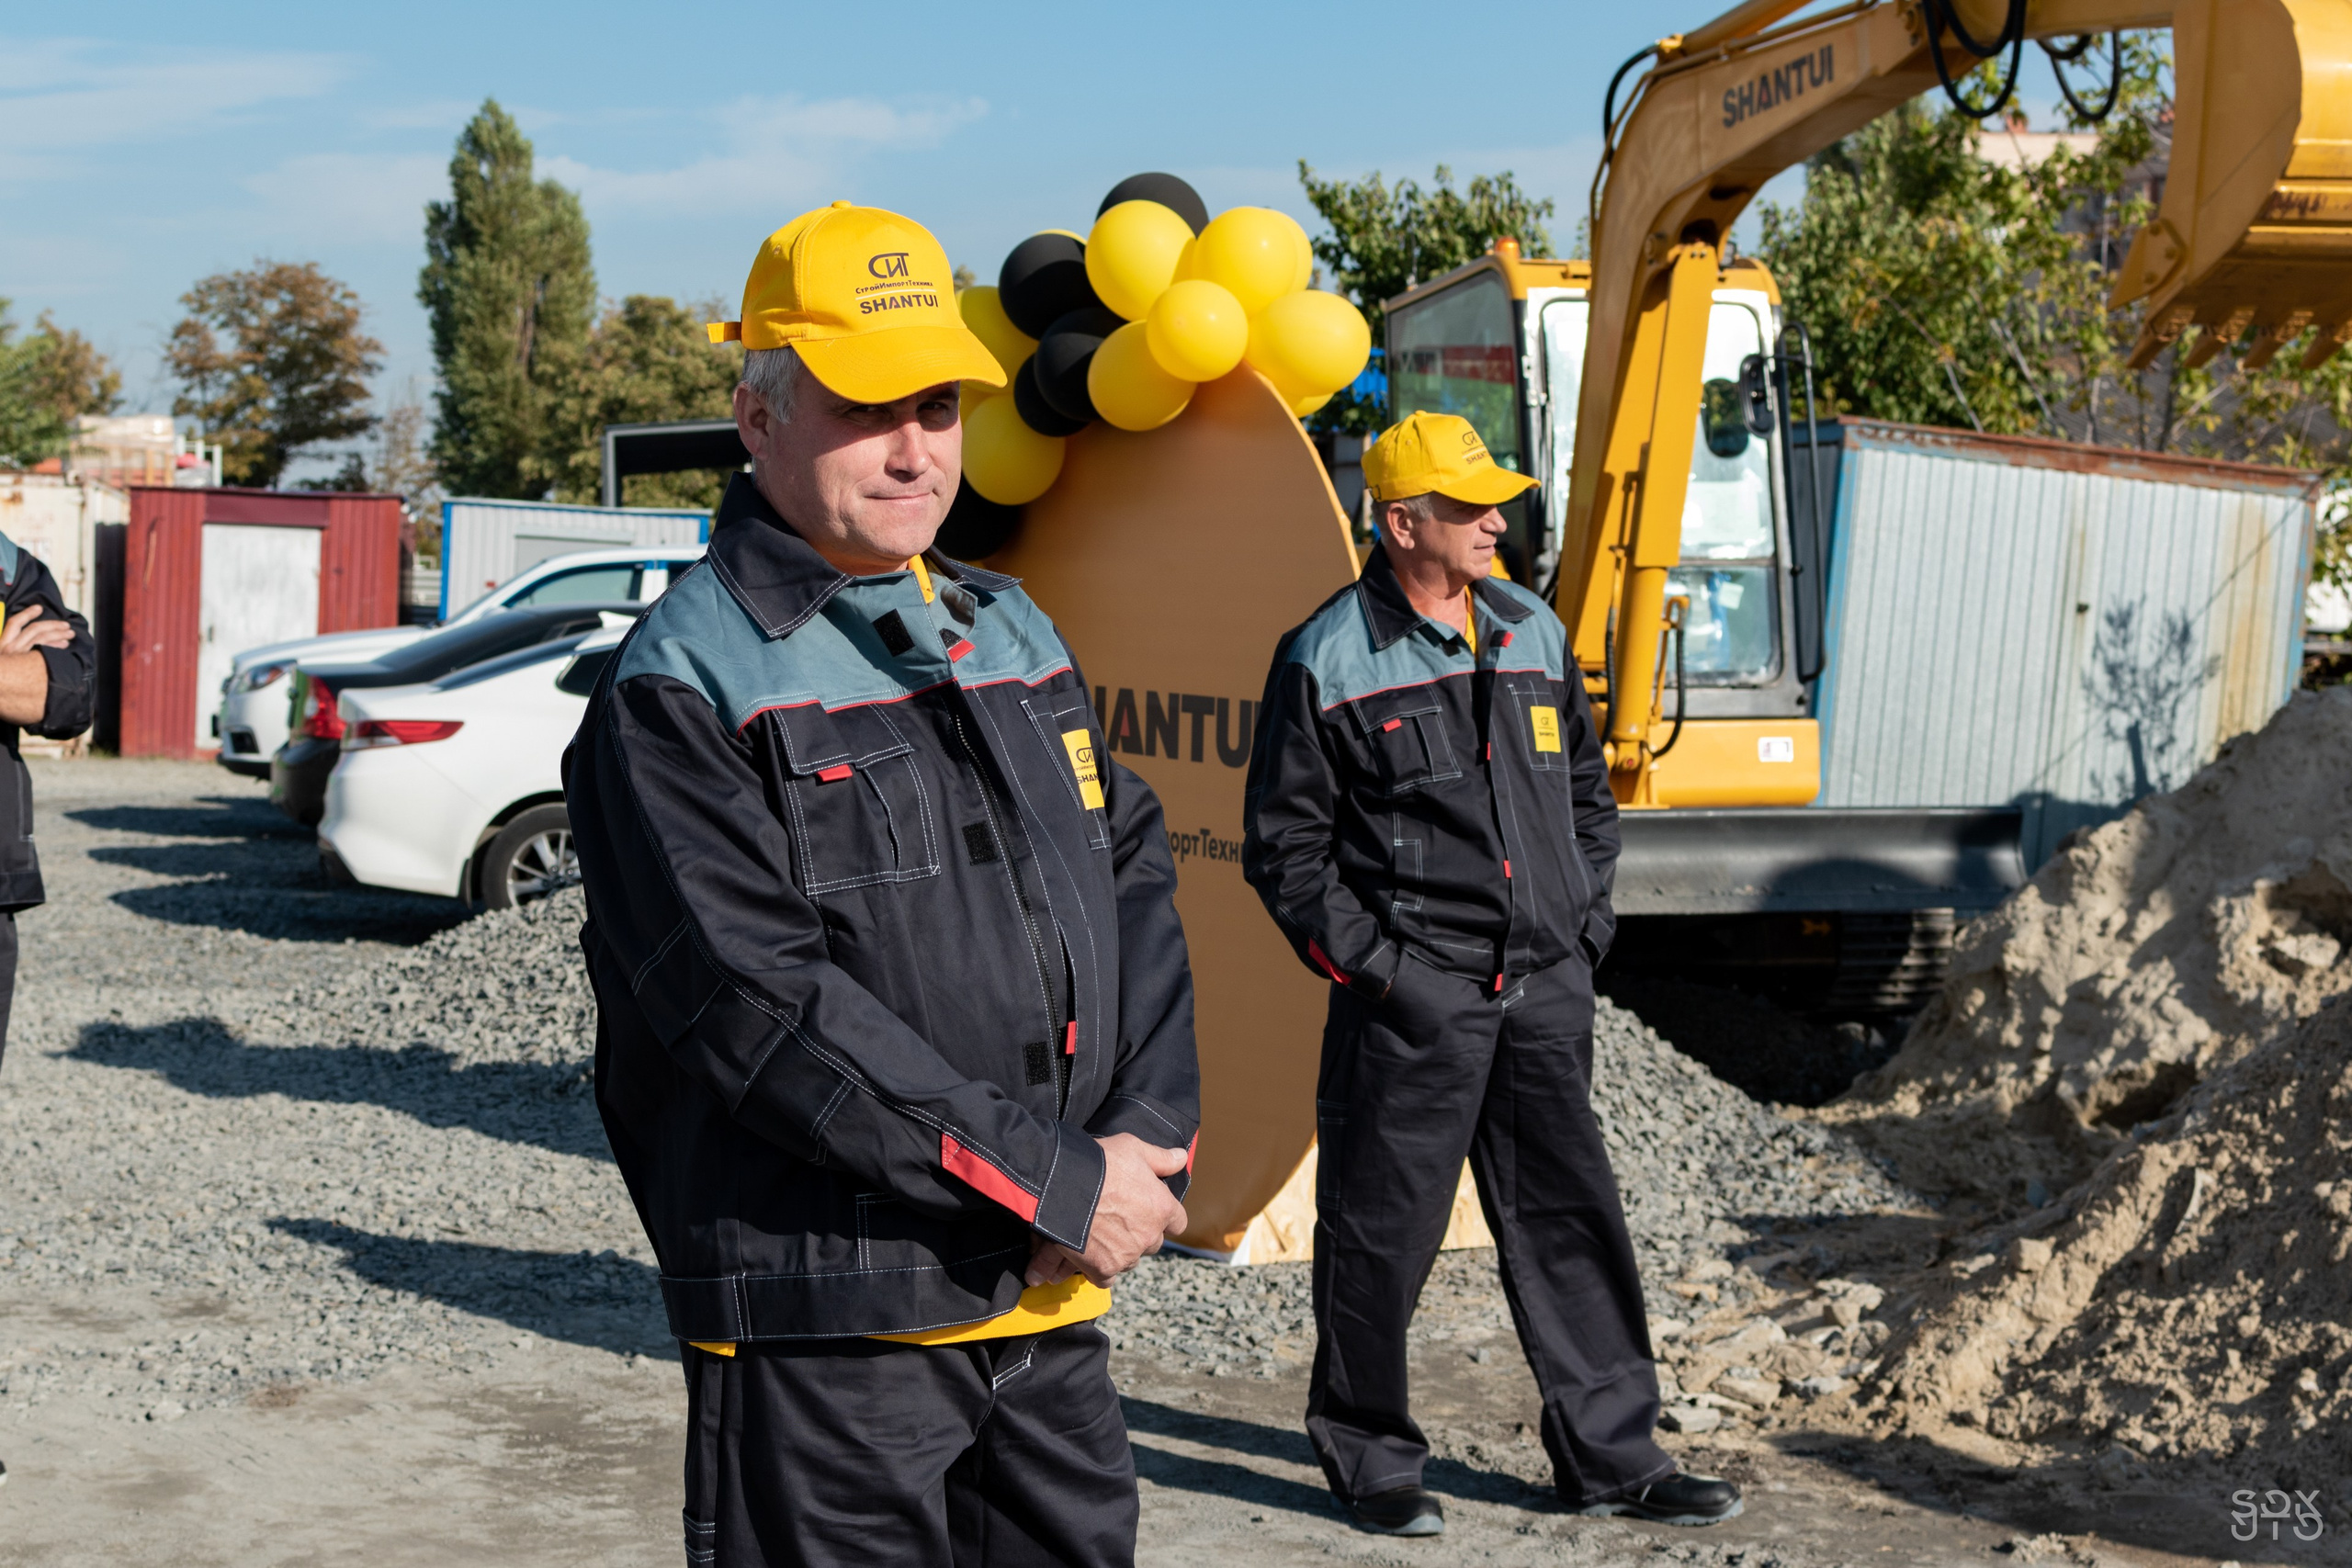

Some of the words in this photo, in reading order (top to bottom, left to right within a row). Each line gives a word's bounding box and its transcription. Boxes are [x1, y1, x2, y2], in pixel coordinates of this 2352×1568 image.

[1723, 43, 1834, 129] SHANTUI
[855, 279, 933, 294] СтройИмпортТехника
[860, 294, 938, 314] SHANTUI
[1166, 829, 1245, 863] ортТехн
